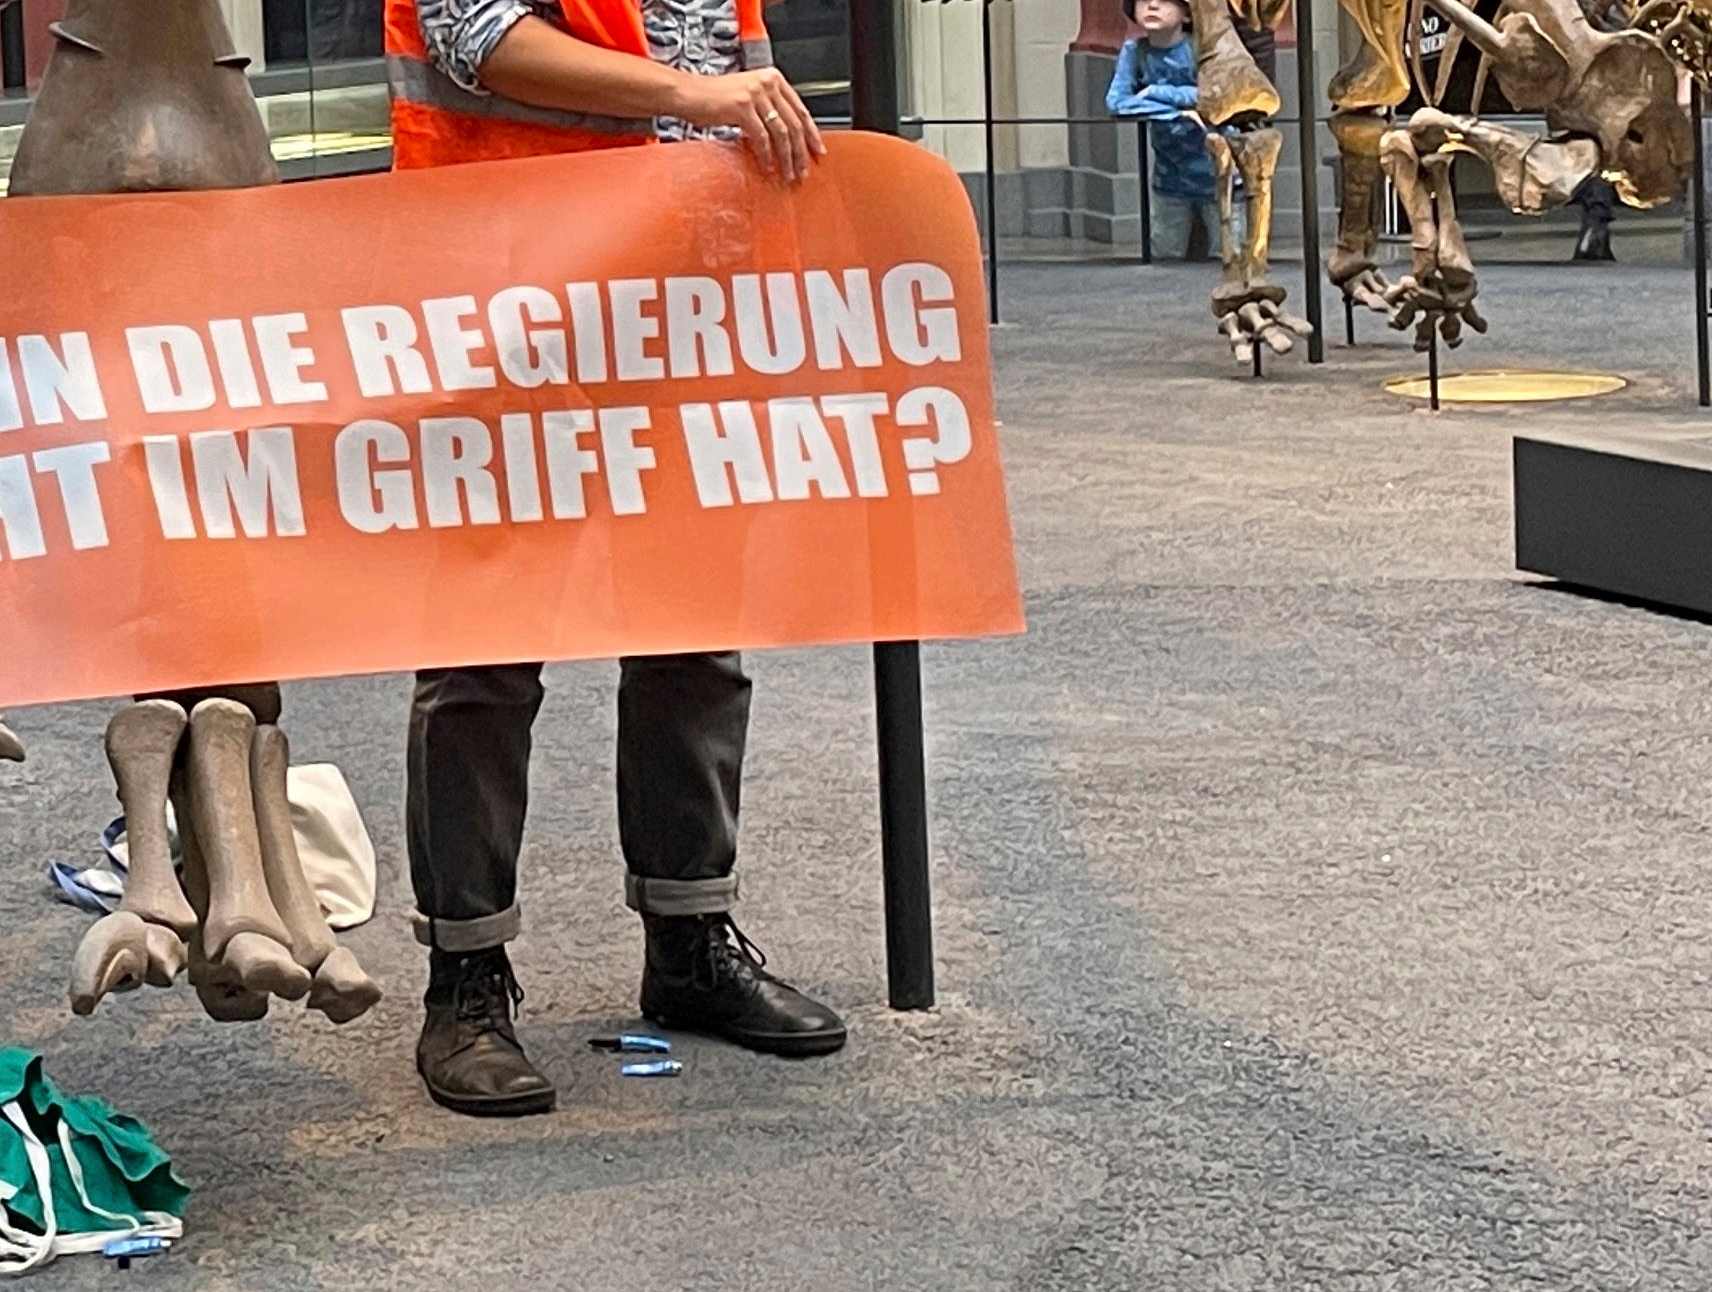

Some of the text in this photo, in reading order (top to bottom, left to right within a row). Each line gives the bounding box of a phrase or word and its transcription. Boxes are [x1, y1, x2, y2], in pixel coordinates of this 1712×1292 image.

[124, 312, 328, 414] DIE
[341, 262, 962, 398] REGIERUNG
[142, 427, 306, 540] IM
[334, 404, 657, 534] GRIFF
[681, 386, 972, 508] HAT?
